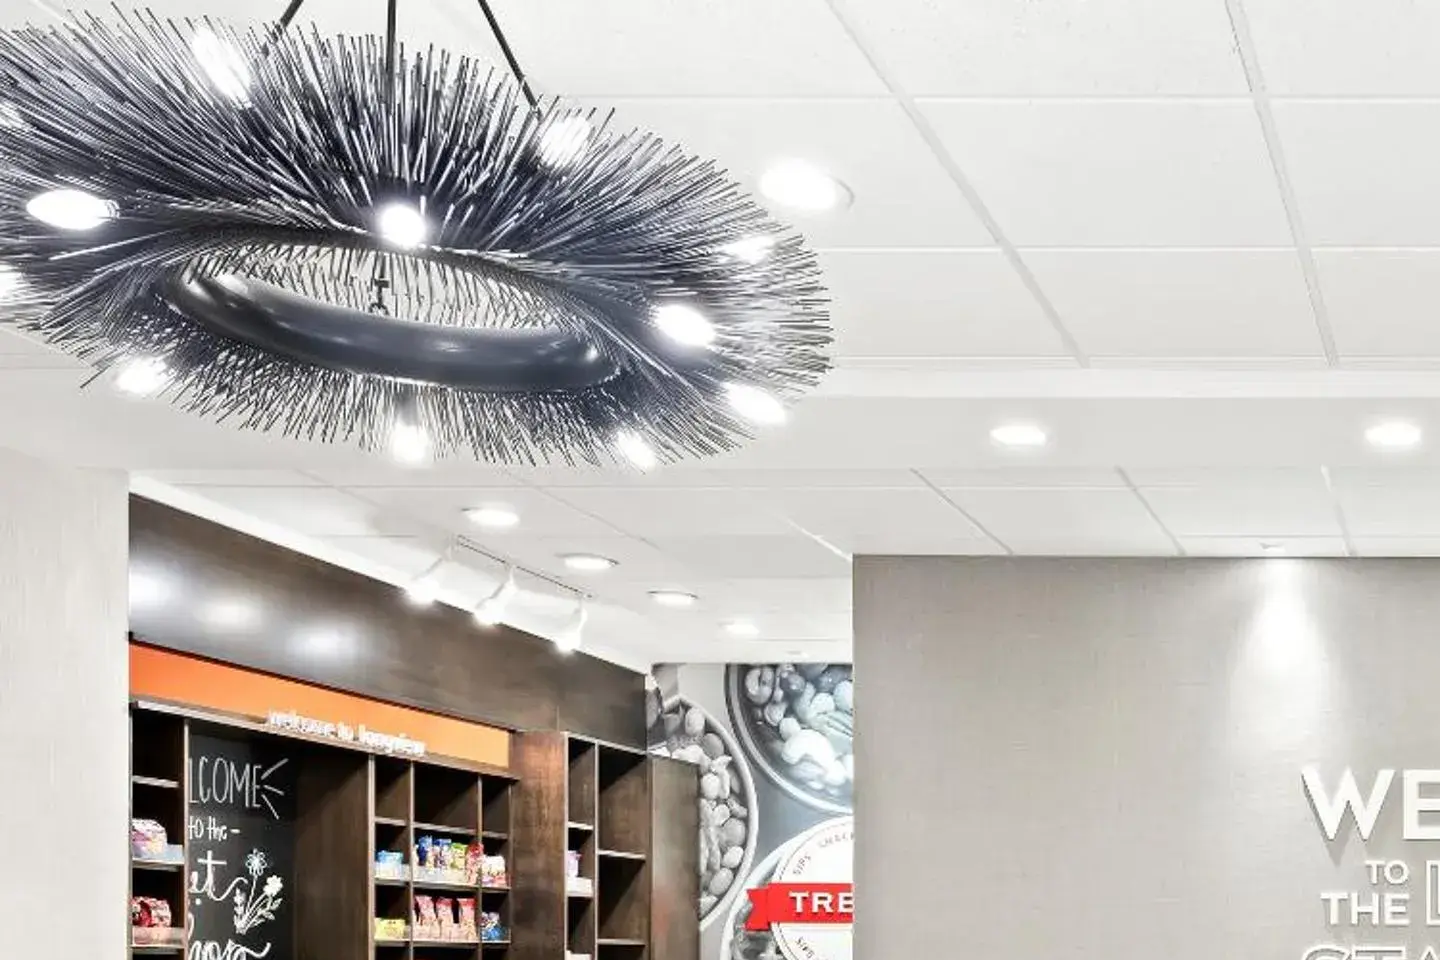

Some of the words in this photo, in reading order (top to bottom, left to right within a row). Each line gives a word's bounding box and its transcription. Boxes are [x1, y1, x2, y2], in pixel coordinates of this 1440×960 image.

[1365, 860, 1410, 884] TO
[788, 891, 854, 914] TRE
[1320, 892, 1411, 926] THE
